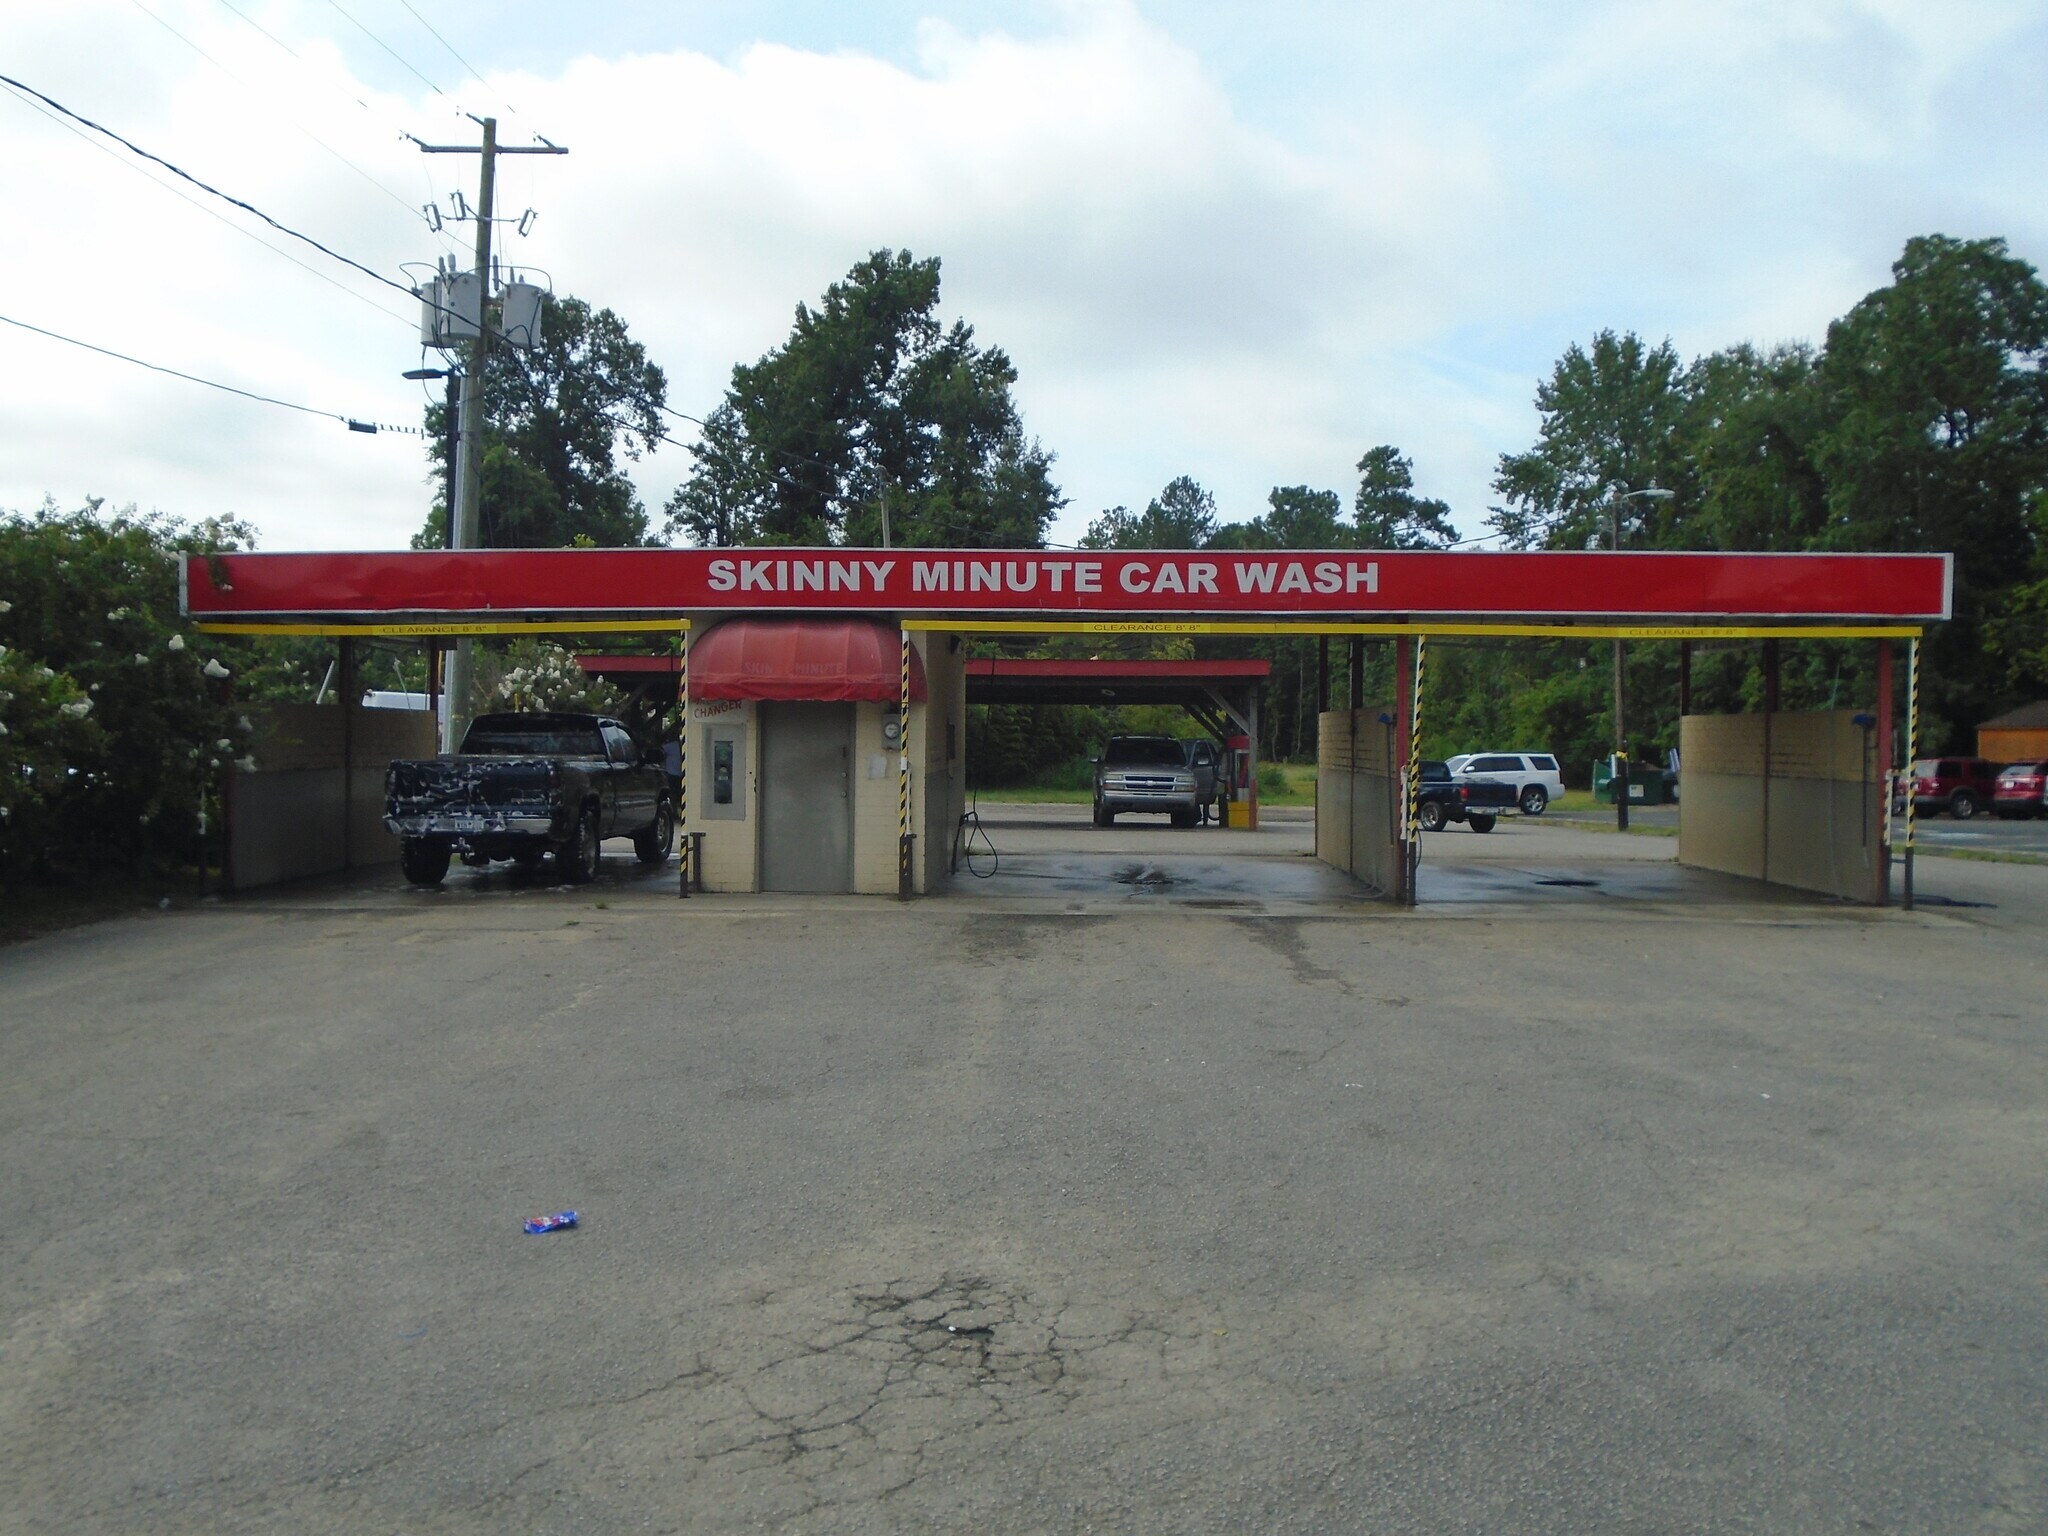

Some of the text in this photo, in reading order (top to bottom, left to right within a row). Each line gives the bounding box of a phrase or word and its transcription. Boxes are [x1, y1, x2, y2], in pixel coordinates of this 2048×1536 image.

[708, 560, 1378, 593] SKINNY MINUTE CAR WASH
[382, 625, 456, 633] CLEARANCE
[1629, 628, 1705, 636] CLEARANCE
[694, 701, 742, 718] CHANGER
